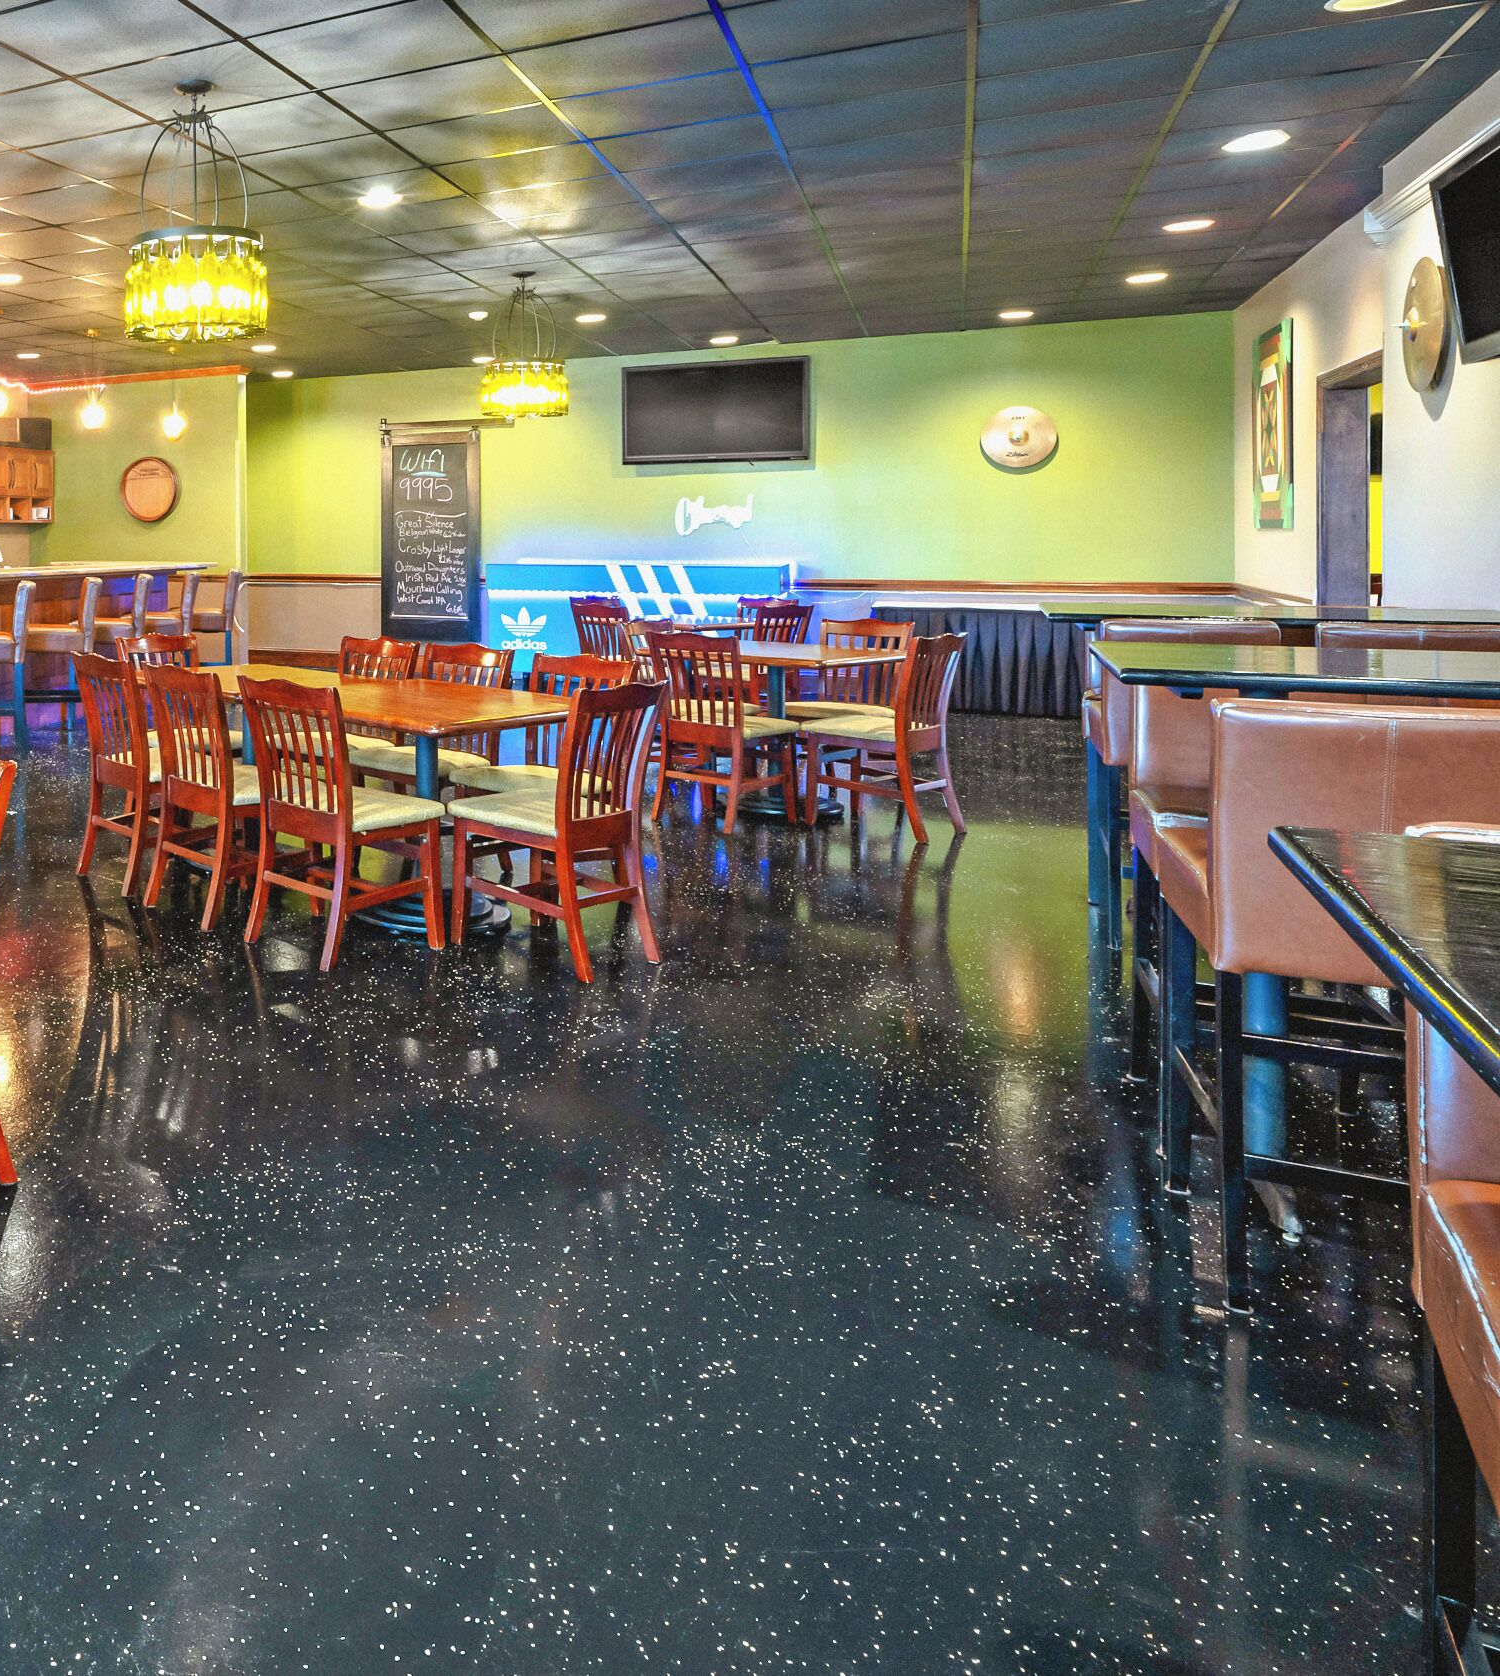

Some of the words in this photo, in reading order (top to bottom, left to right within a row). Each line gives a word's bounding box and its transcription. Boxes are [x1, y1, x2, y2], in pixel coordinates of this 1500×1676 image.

[399, 477, 453, 503] 9995
[396, 514, 422, 529] Great
[424, 512, 455, 529] Silence
[398, 537, 433, 559] Crosby
[448, 540, 467, 558] Lager
[405, 572, 424, 583] Irish
[425, 573, 439, 583] Red
[440, 572, 453, 584] Ale
[396, 580, 436, 596] Mountain
[436, 582, 463, 602] Calling
[396, 594, 415, 604] West
[415, 594, 435, 605] Coast
[435, 596, 447, 606] IPA
[501, 638, 548, 651] adidas
